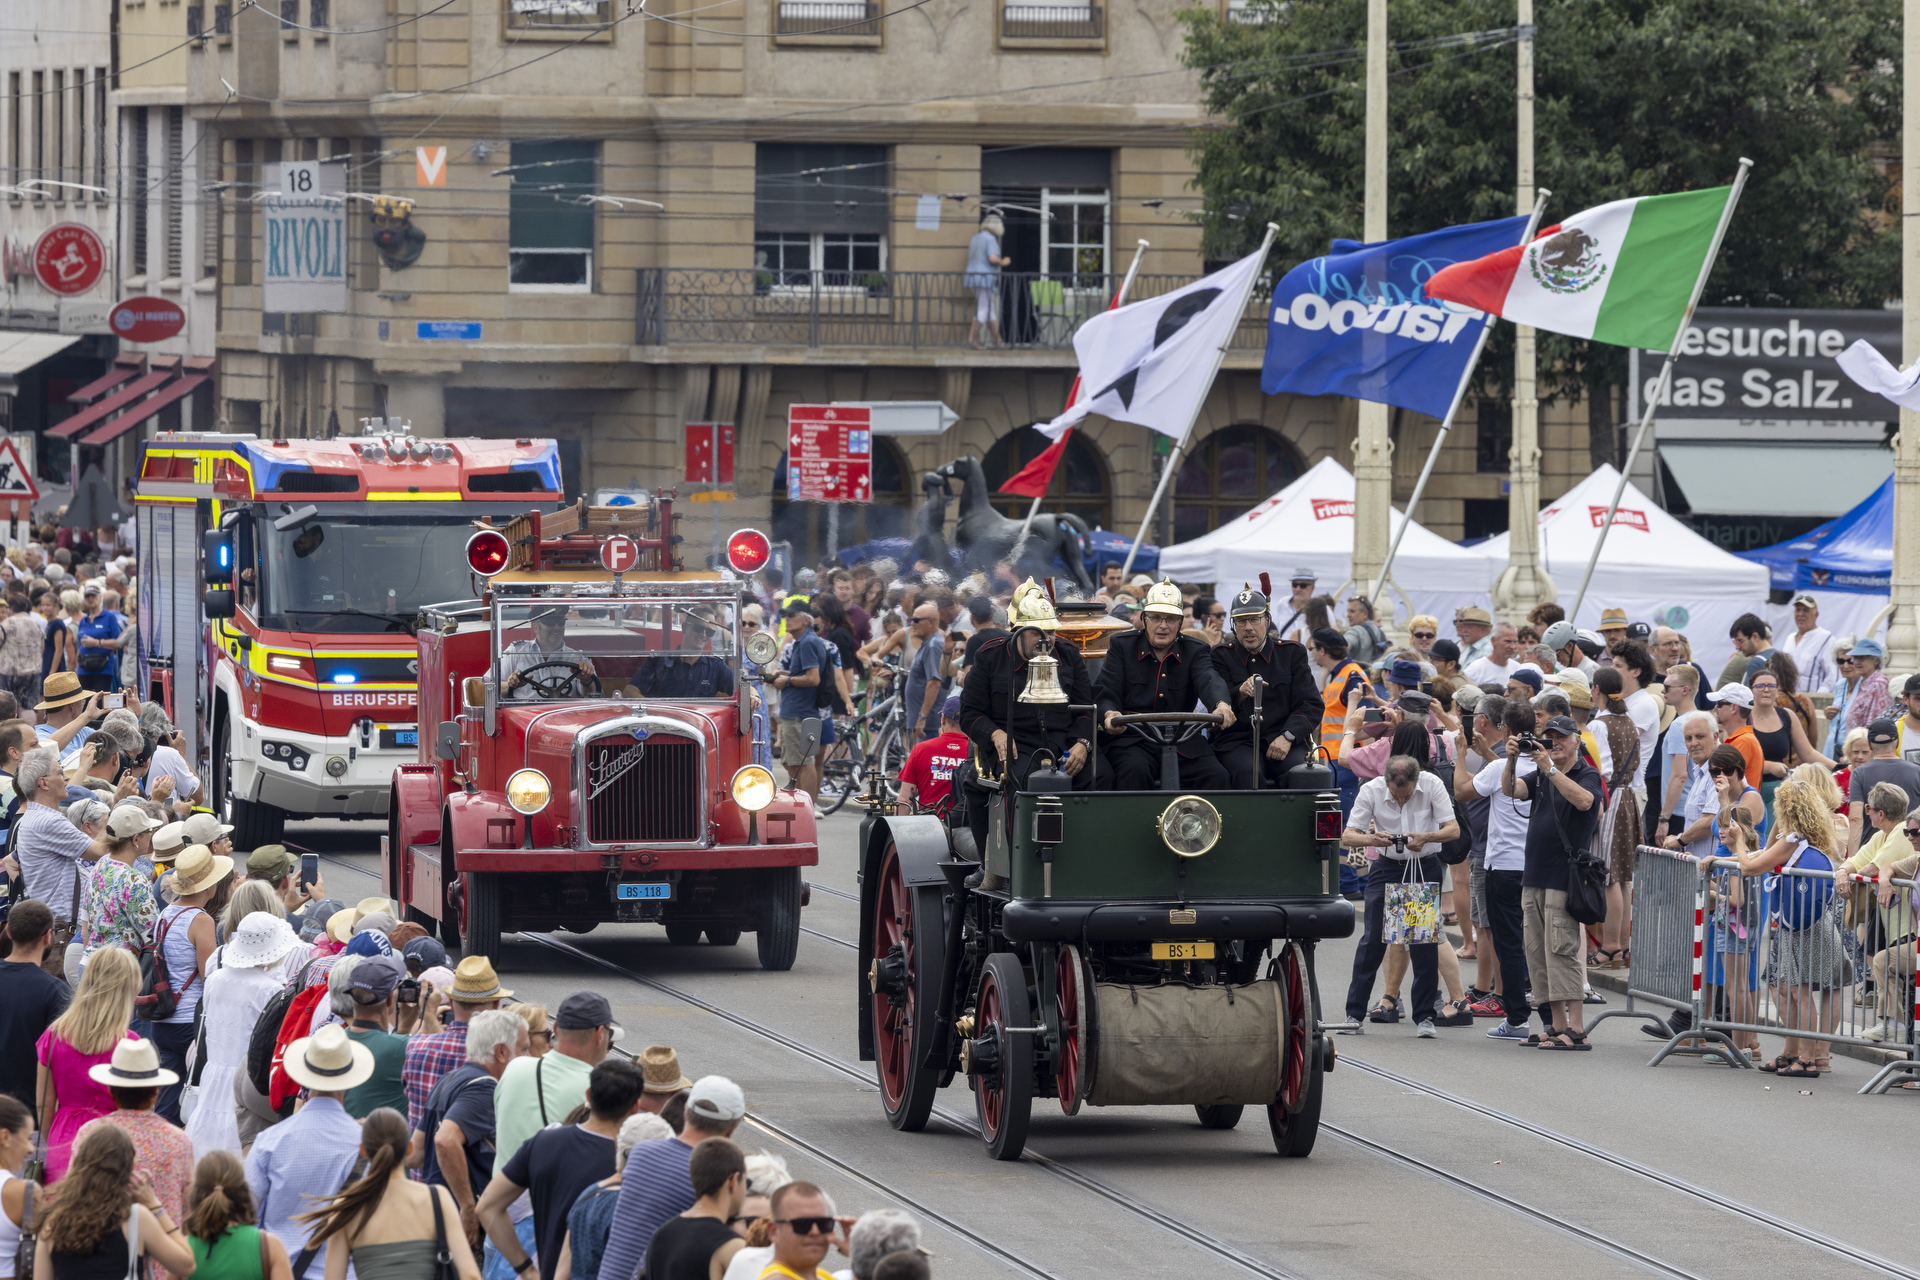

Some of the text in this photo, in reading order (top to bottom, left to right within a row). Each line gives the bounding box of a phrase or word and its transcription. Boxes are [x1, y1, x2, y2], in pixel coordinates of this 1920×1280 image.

[288, 169, 312, 192] 18
[56, 229, 80, 240] CARL
[268, 217, 342, 278] RIVOLI
[1646, 319, 1845, 358] esuche
[1643, 364, 1852, 409] das Salz.
[1317, 503, 1355, 519] rivell
[611, 540, 627, 568] F
